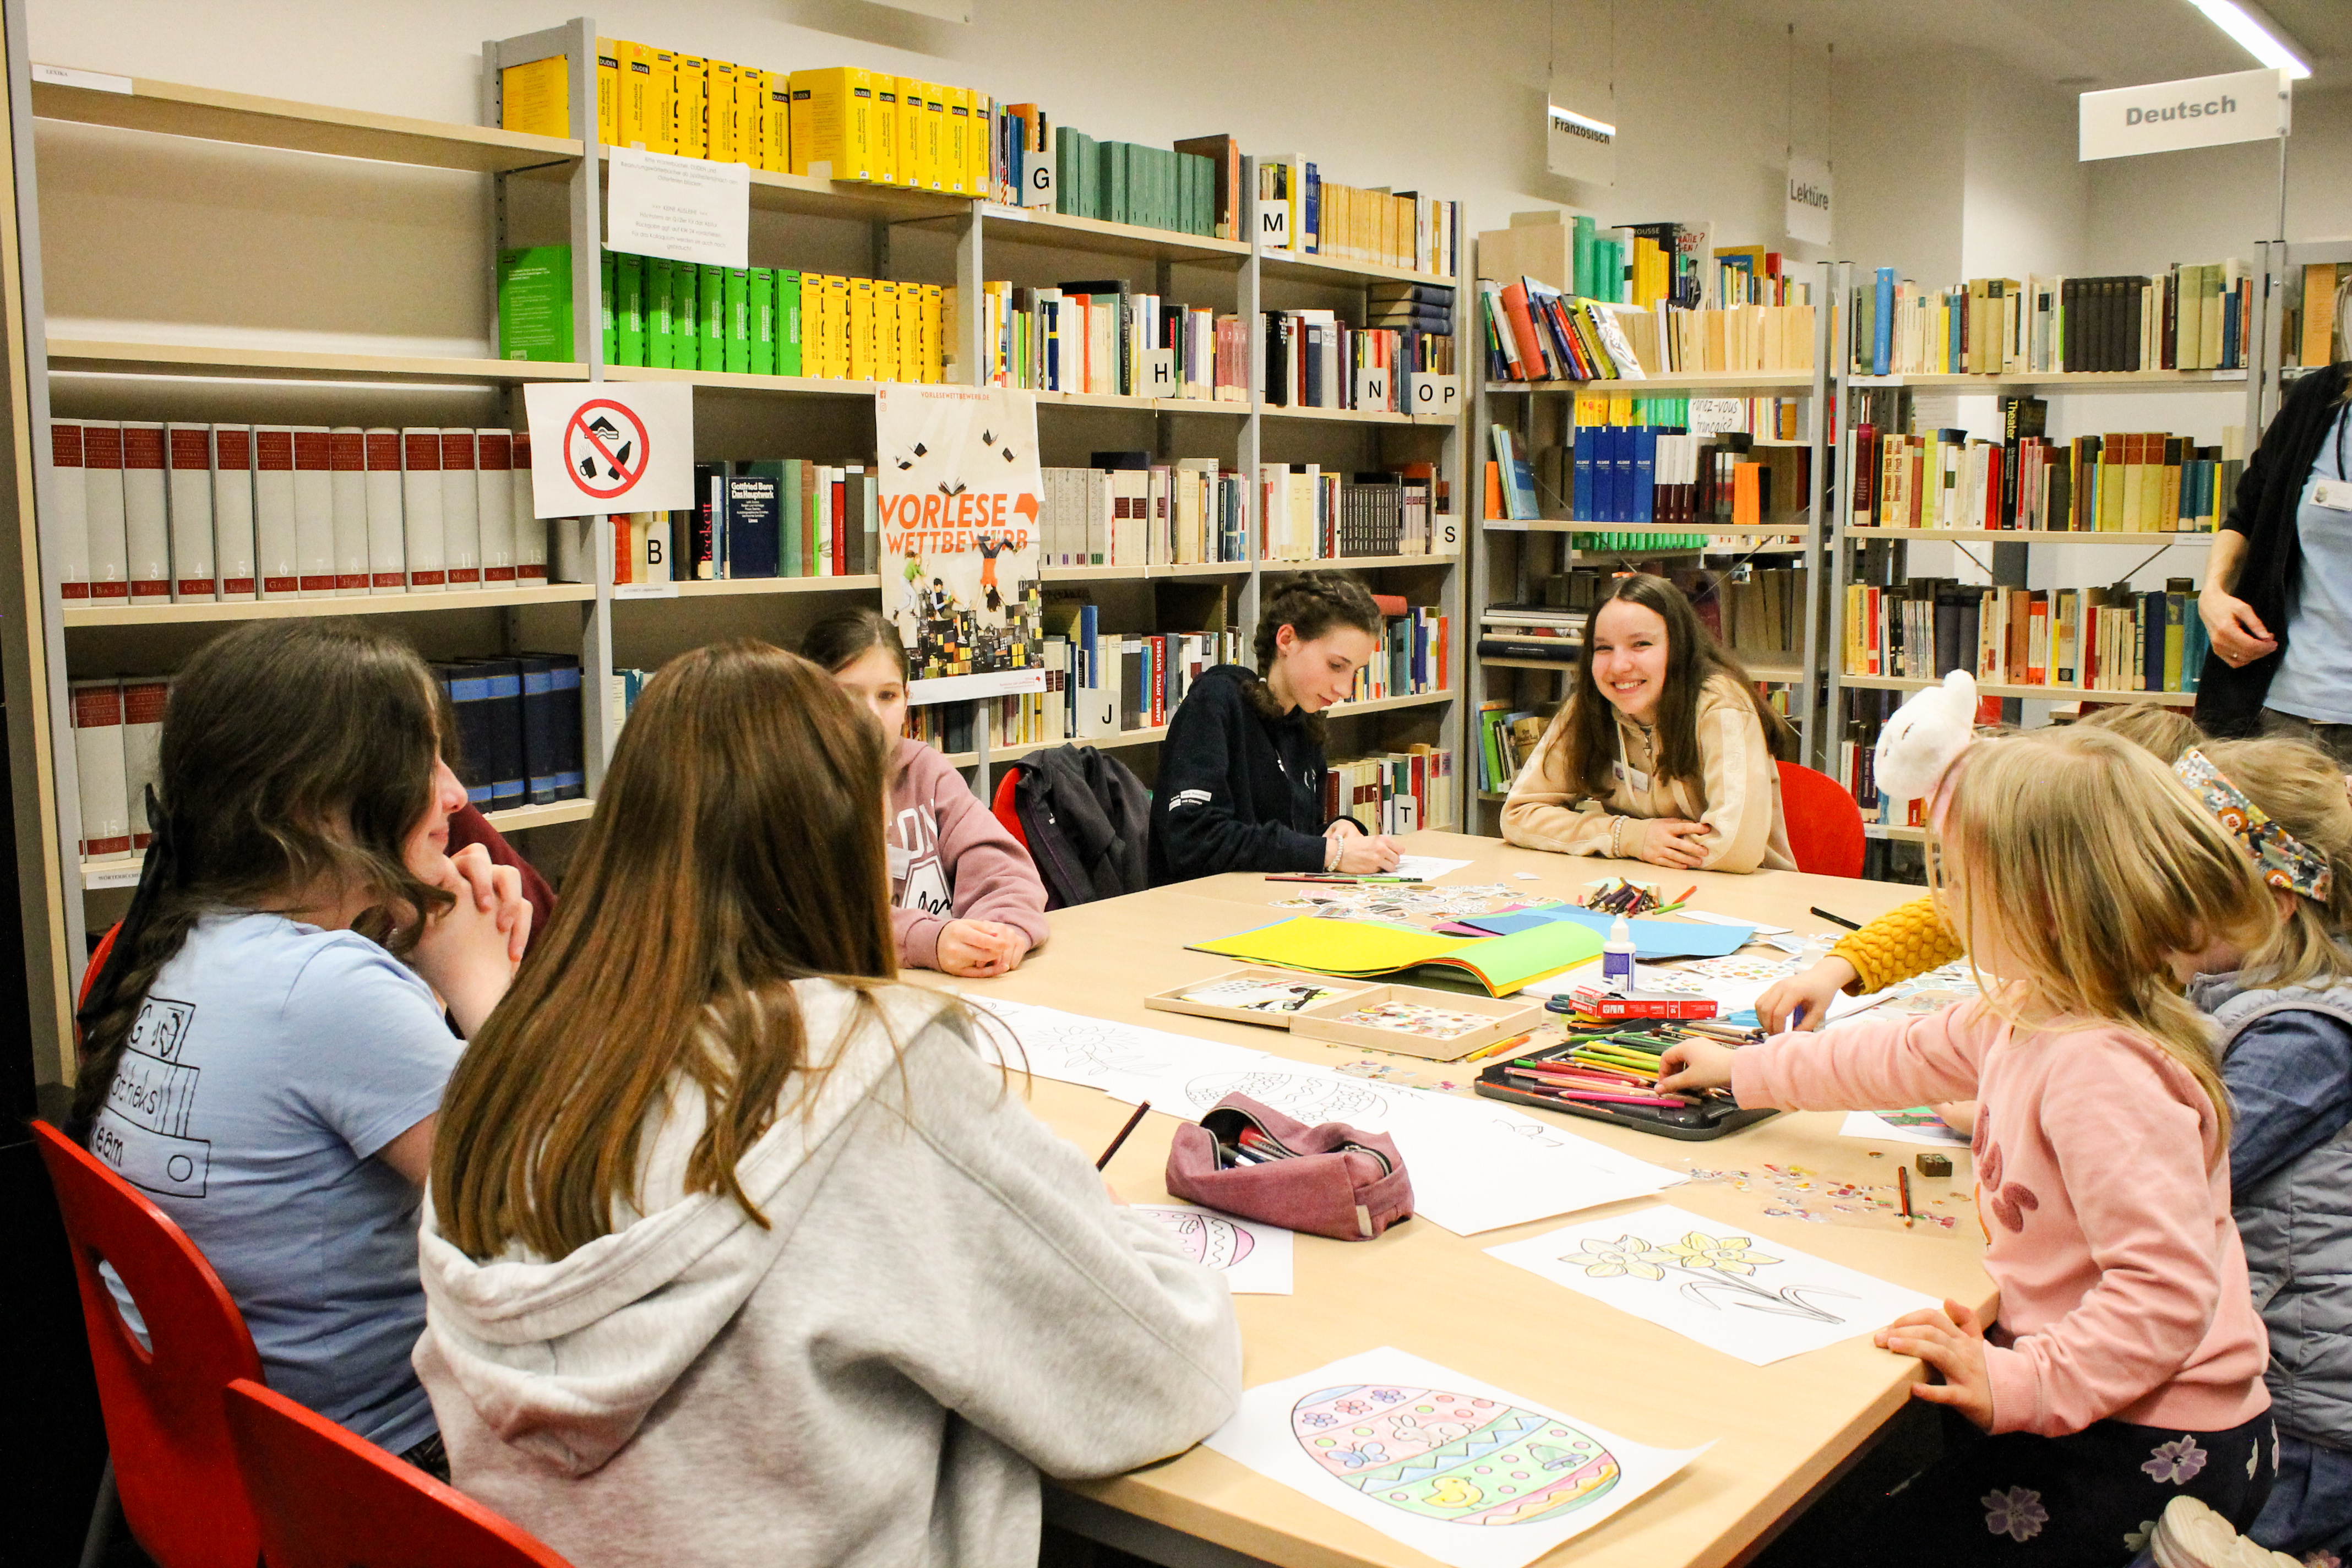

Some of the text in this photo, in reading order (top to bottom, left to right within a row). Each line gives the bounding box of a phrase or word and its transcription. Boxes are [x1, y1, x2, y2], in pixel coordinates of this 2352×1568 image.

[599, 58, 617, 68] DUDEN
[632, 64, 649, 74] DUDEN
[772, 92, 788, 102] DUDEN
[928, 104, 942, 112] DUDEN
[2126, 95, 2236, 126] Deutsch
[1033, 167, 1049, 189] G
[1790, 179, 1829, 210] Lektüre
[1264, 213, 1283, 232] M
[1227, 331, 1232, 340] 2
[1155, 363, 1167, 383] H
[921, 391, 990, 400] VORLESEWETTBEWERB.DE
[1369, 380, 1381, 398] N
[1419, 384, 1433, 401] O
[1444, 387, 1455, 404] P
[2006, 399, 2018, 440] Theater
[731, 481, 774, 491] Gottfried Benn
[731, 490, 774, 500] Das Hauptwerk
[879, 493, 1008, 530] VORLESE
[1445, 526, 1455, 542] S
[886, 529, 1028, 556] WETTBEWERB
[496, 552, 508, 566] 12
[647, 540, 661, 564] B
[238, 560, 246, 576] 5
[279, 560, 288, 575] 6
[316, 559, 324, 574] 7
[351, 557, 358, 573] 8
[388, 556, 396, 571] 9
[424, 556, 437, 569] 10
[461, 553, 471, 568] 11
[69, 565, 75, 581] 1
[107, 564, 115, 580] 2
[150, 563, 159, 579] 3
[194, 562, 203, 578] 4
[1102, 704, 1112, 724] J
[1400, 807, 1411, 823] T
[102, 820, 118, 837] 15
[98, 872, 142, 881] WÖRTERBÜCHE
